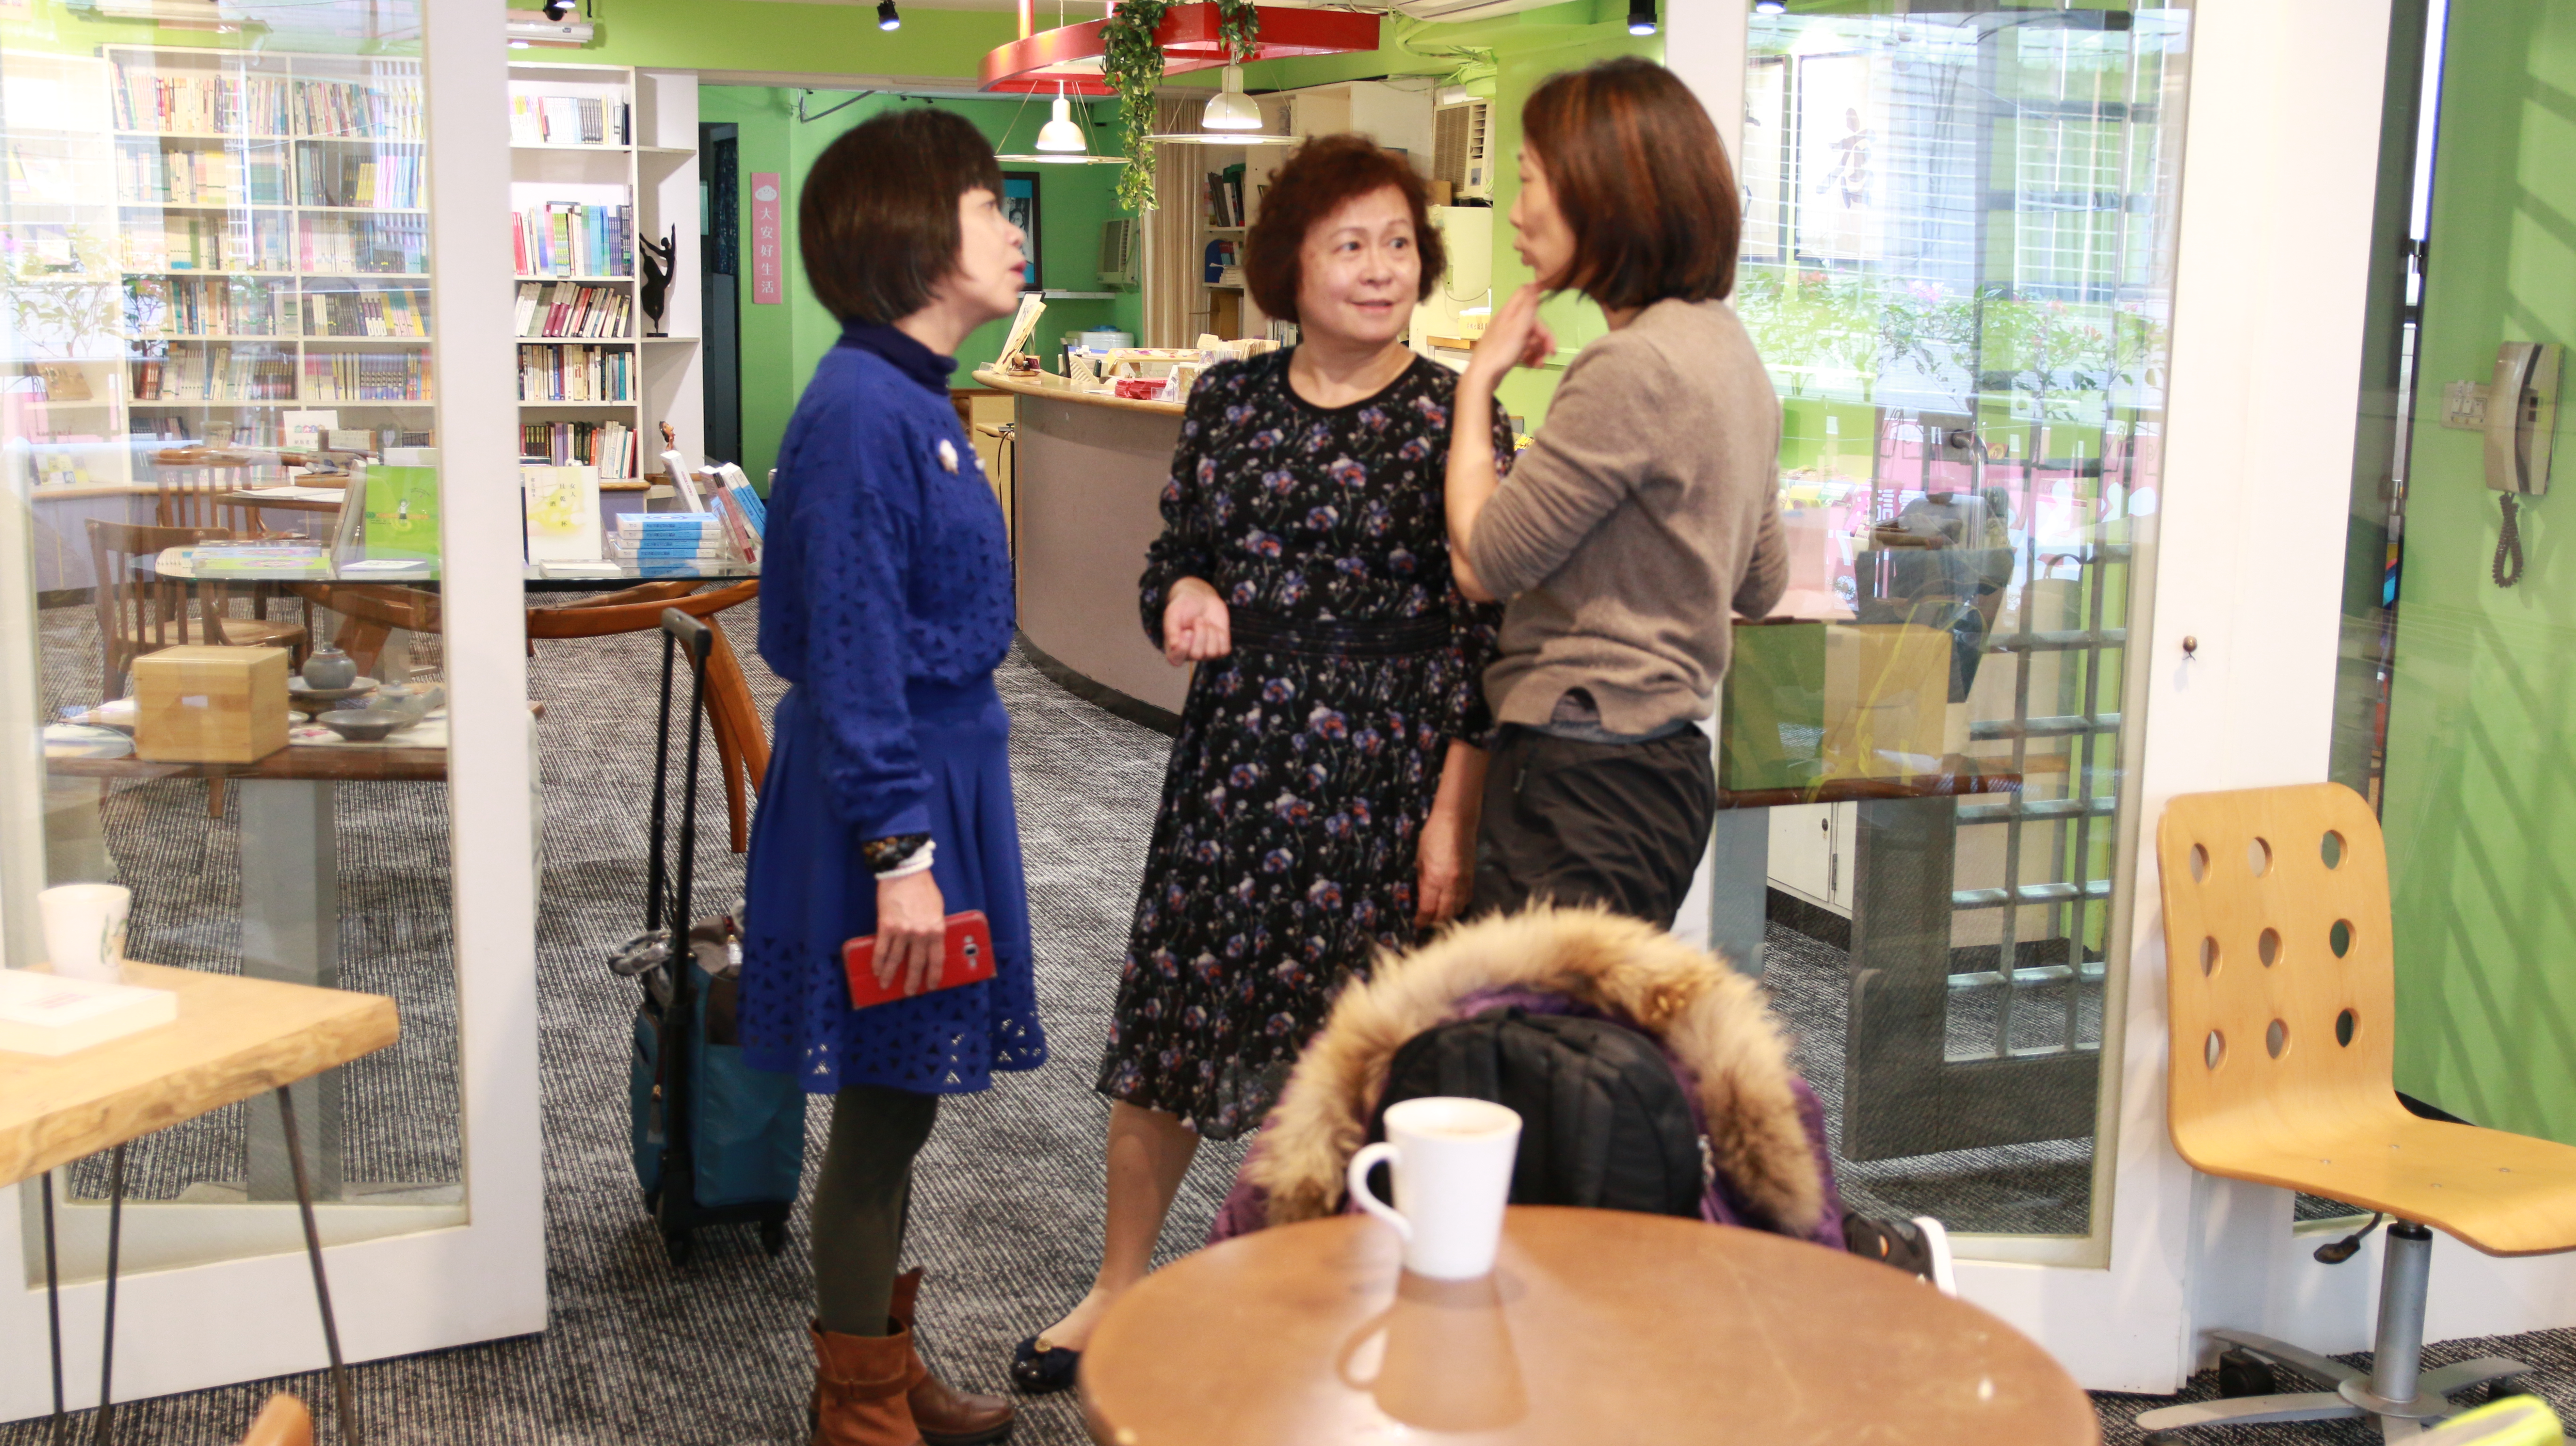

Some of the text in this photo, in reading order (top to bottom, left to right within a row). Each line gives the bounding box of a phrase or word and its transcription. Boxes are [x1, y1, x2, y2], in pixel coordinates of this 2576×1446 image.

[760, 207, 774, 293] 大安好生活
[570, 483, 576, 497] 女人
